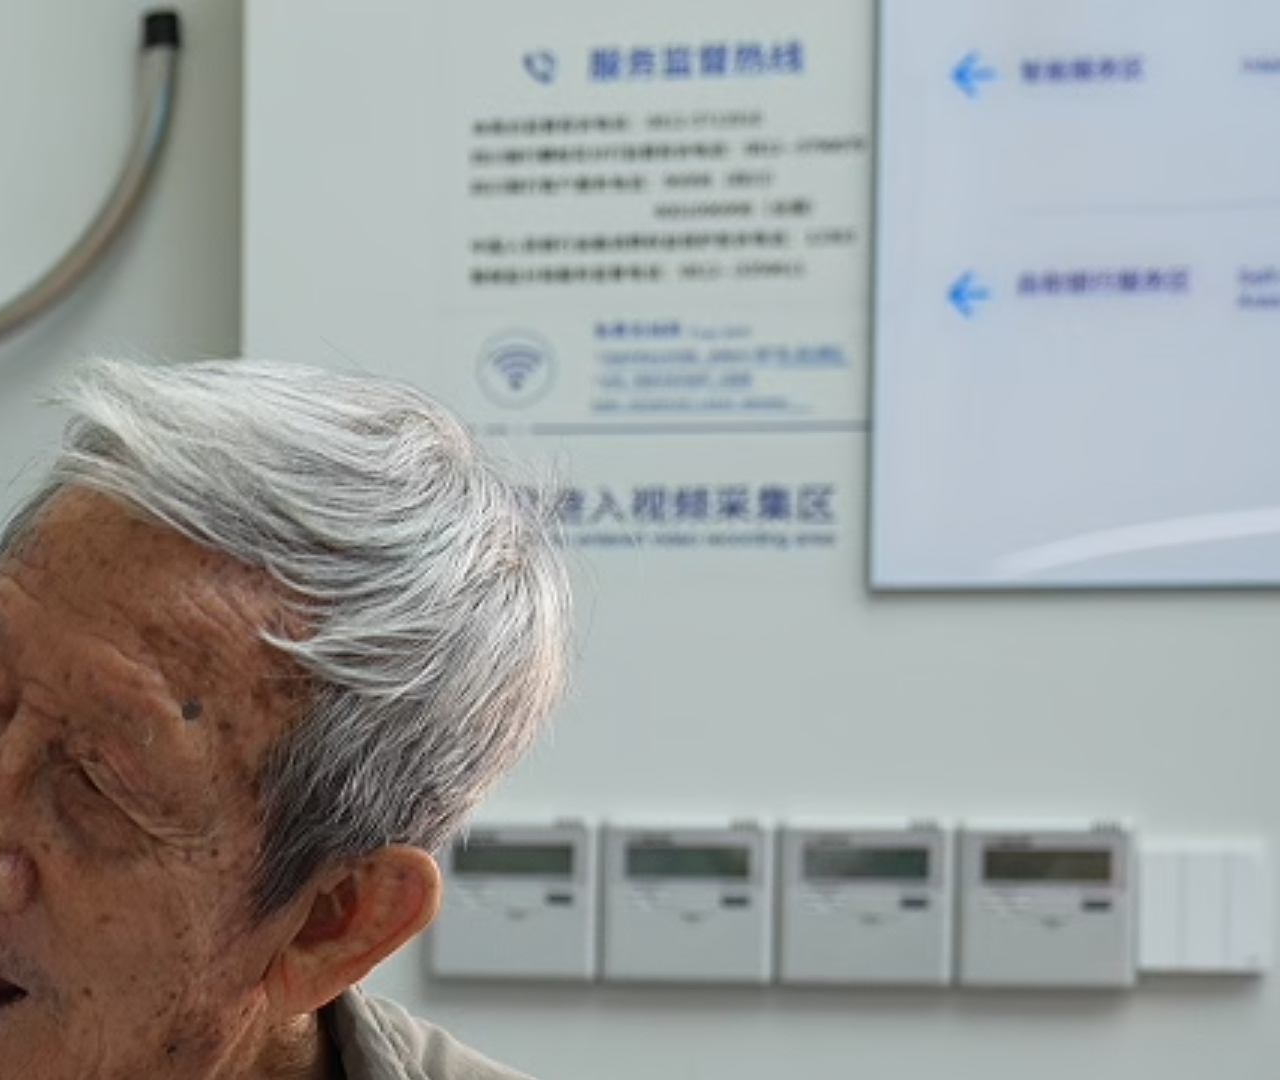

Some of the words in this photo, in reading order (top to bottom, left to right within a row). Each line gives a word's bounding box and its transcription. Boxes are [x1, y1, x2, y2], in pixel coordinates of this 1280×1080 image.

[589, 40, 804, 82] 服务监督热线
